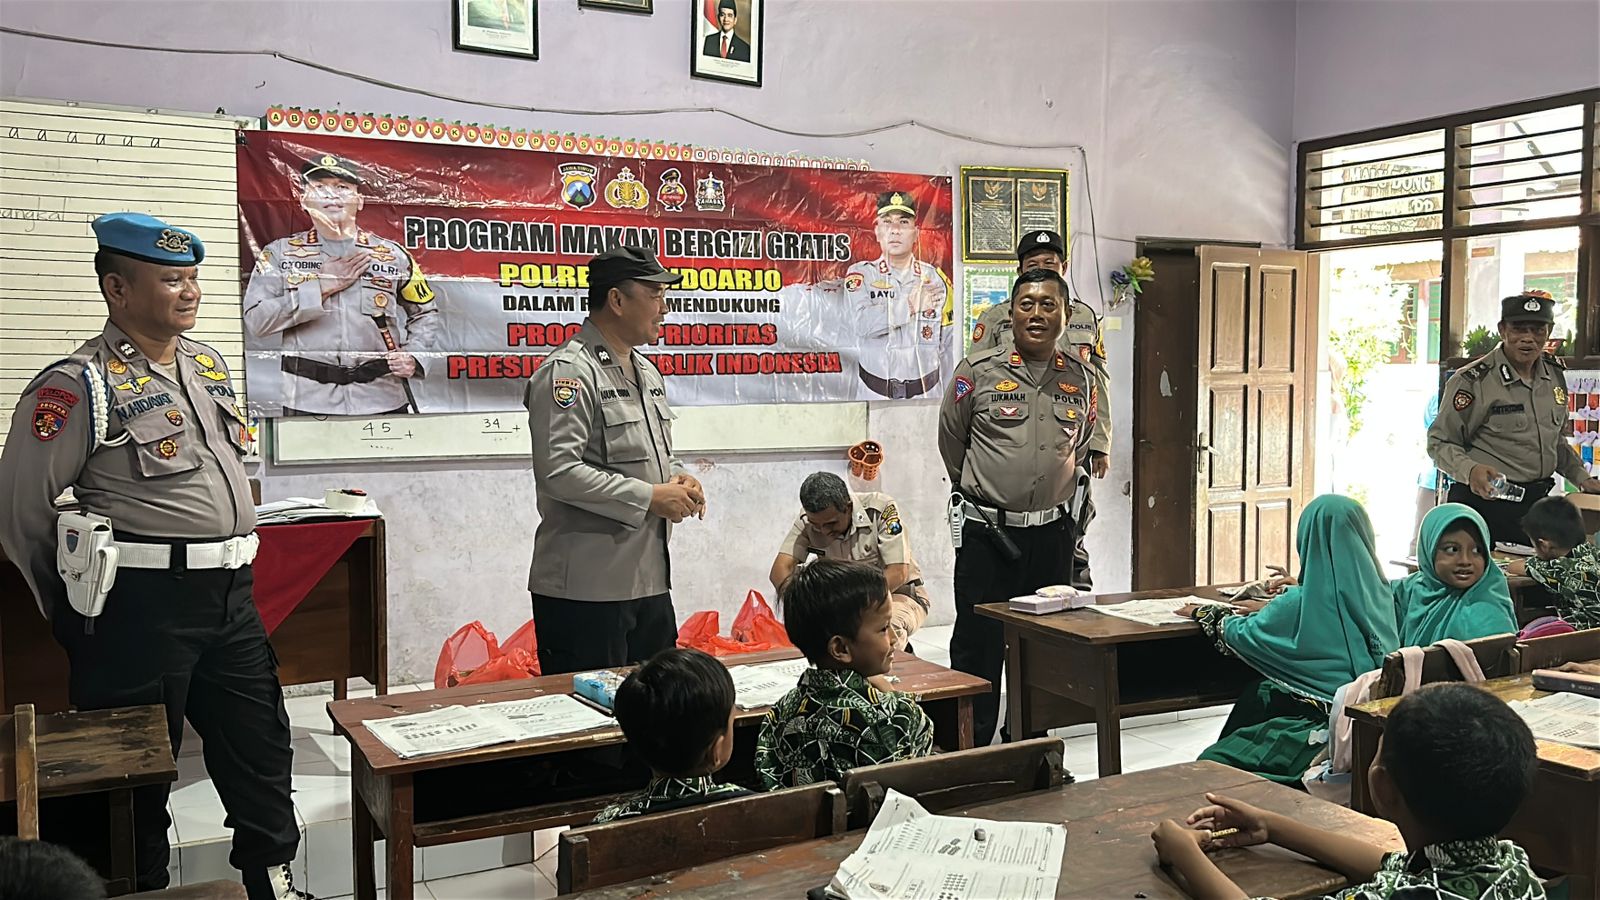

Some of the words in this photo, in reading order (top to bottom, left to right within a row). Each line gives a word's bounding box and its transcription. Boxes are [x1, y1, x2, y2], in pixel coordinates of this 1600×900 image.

[9, 127, 20, 138] a
[37, 129, 48, 142] a
[67, 131, 78, 144] a
[96, 134, 106, 146] a
[122, 136, 133, 148] a
[150, 137, 160, 148] a
[0, 197, 67, 232] angkal
[405, 217, 554, 253] PROGRAM
[562, 225, 657, 255] MAKAN
[665, 229, 761, 258] BERGIZI
[767, 233, 851, 261] GRATIS
[371, 263, 398, 275] OLRI
[499, 262, 590, 288] POLRE
[665, 267, 782, 292] IDOARJO
[870, 290, 895, 299] BAYU
[502, 295, 576, 312] DALAM
[665, 298, 781, 313] MENDUKUNG
[1069, 323, 1092, 331] POLRI
[648, 353, 714, 377] BLIK
[716, 352, 843, 375] INDONESIA
[1054, 394, 1083, 407] POLRI
[483, 417, 501, 429] 34
